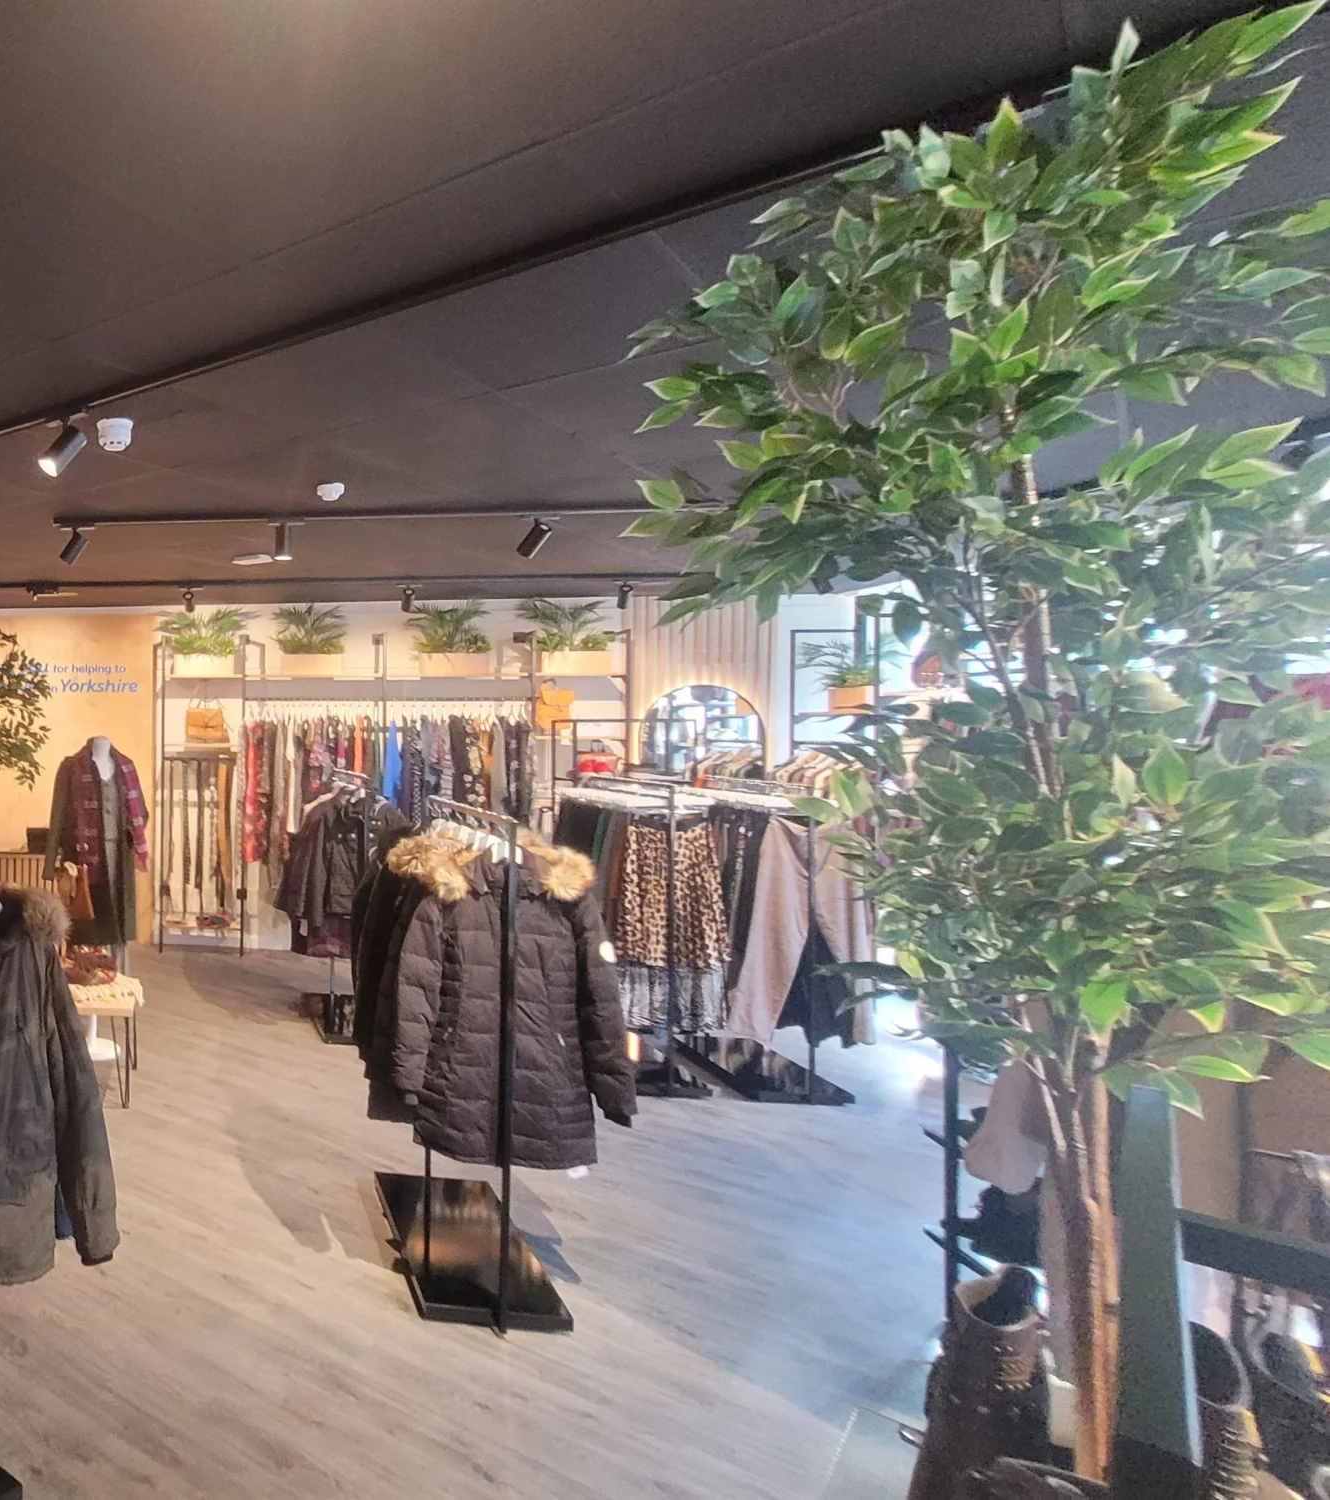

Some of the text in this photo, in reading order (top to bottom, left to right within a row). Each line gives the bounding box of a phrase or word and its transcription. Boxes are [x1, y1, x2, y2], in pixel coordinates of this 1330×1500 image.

[53, 664, 68, 673] for
[71, 664, 111, 675] helping
[115, 664, 127, 673] to
[60, 679, 138, 692] Yorkshire
